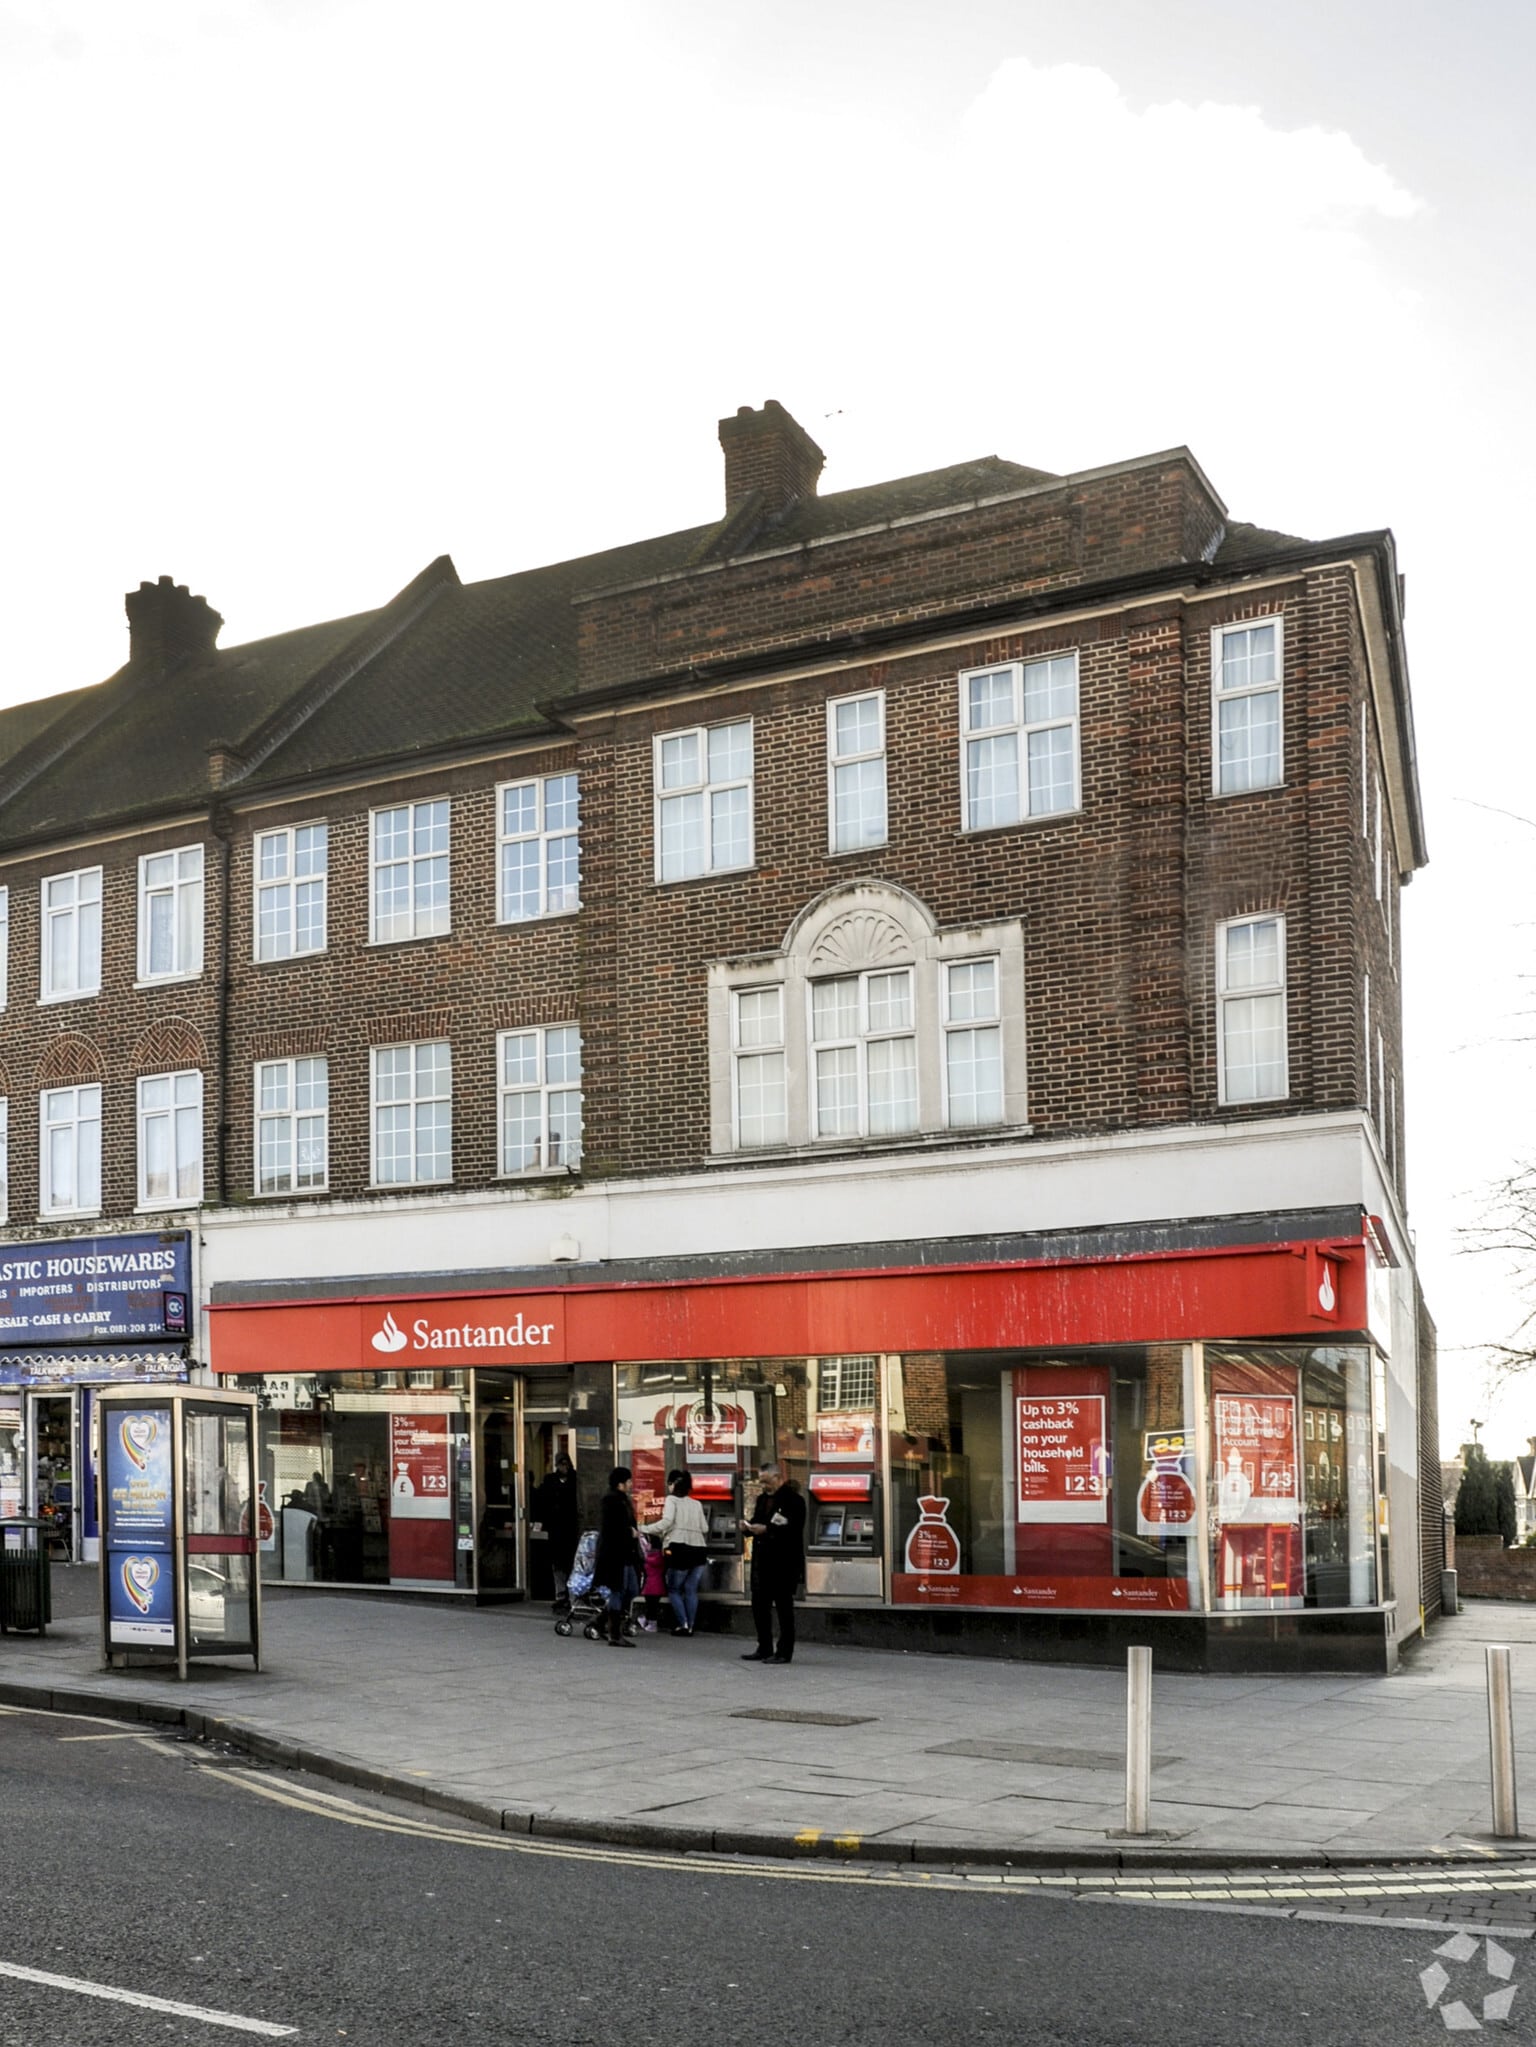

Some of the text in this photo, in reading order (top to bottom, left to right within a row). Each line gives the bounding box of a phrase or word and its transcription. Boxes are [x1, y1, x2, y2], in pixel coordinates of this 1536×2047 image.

[0, 1250, 176, 1280] STIC HOUSEWARES
[19, 1284, 73, 1297] IMPORTERS
[86, 1279, 162, 1293] DISTRIBUTORS
[73, 1311, 112, 1323] CARRY
[413, 1312, 555, 1349] Santander
[1022, 1401, 1080, 1418] Up to 3%
[393, 1416, 409, 1428] 3%
[1022, 1417, 1074, 1429] cashback
[394, 1438, 410, 1448] your
[1023, 1435, 1068, 1447] on your
[1223, 1437, 1261, 1446] Account.
[1023, 1446, 1084, 1458] household
[1023, 1460, 1049, 1473] bills.
[828, 1479, 861, 1488] Santander
[1023, 1586, 1057, 1595] Santander
[1122, 1588, 1158, 1597] Santander
